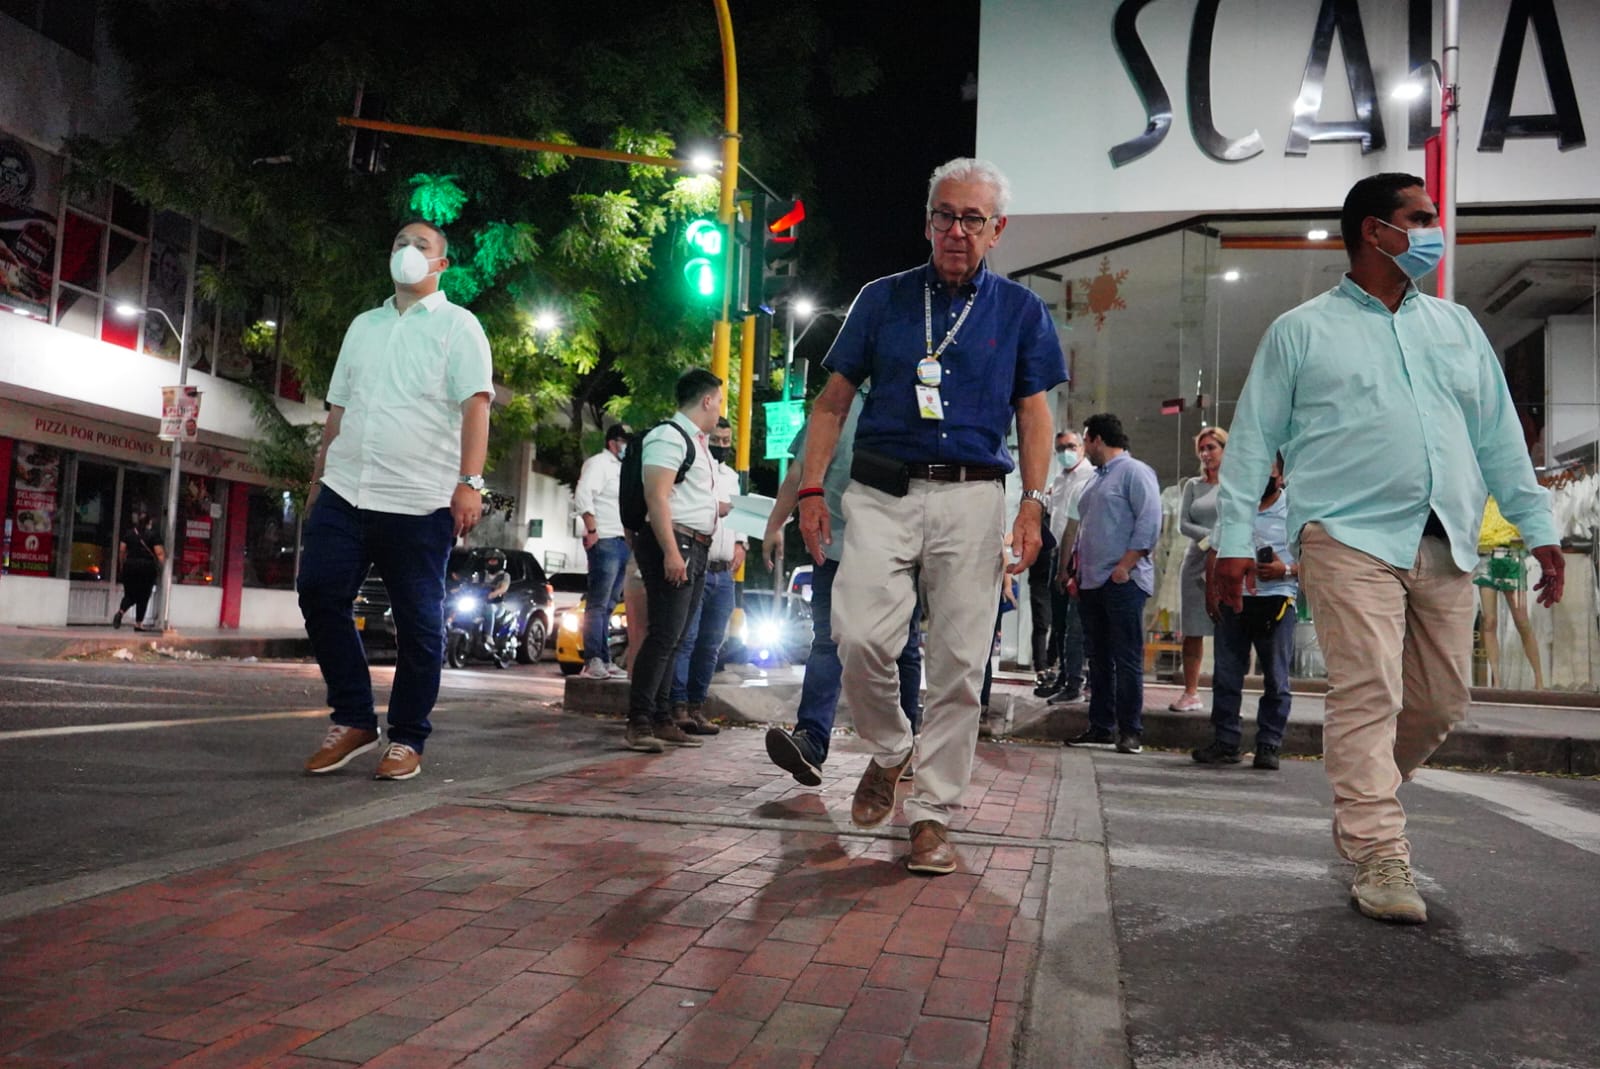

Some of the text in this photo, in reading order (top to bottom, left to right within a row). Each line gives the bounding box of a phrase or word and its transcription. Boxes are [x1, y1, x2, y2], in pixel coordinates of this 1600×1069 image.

[1108, 0, 1587, 169] SCALA
[35, 418, 68, 436] PIZZA
[71, 426, 94, 441] POR
[96, 432, 154, 454] PORCIONES
